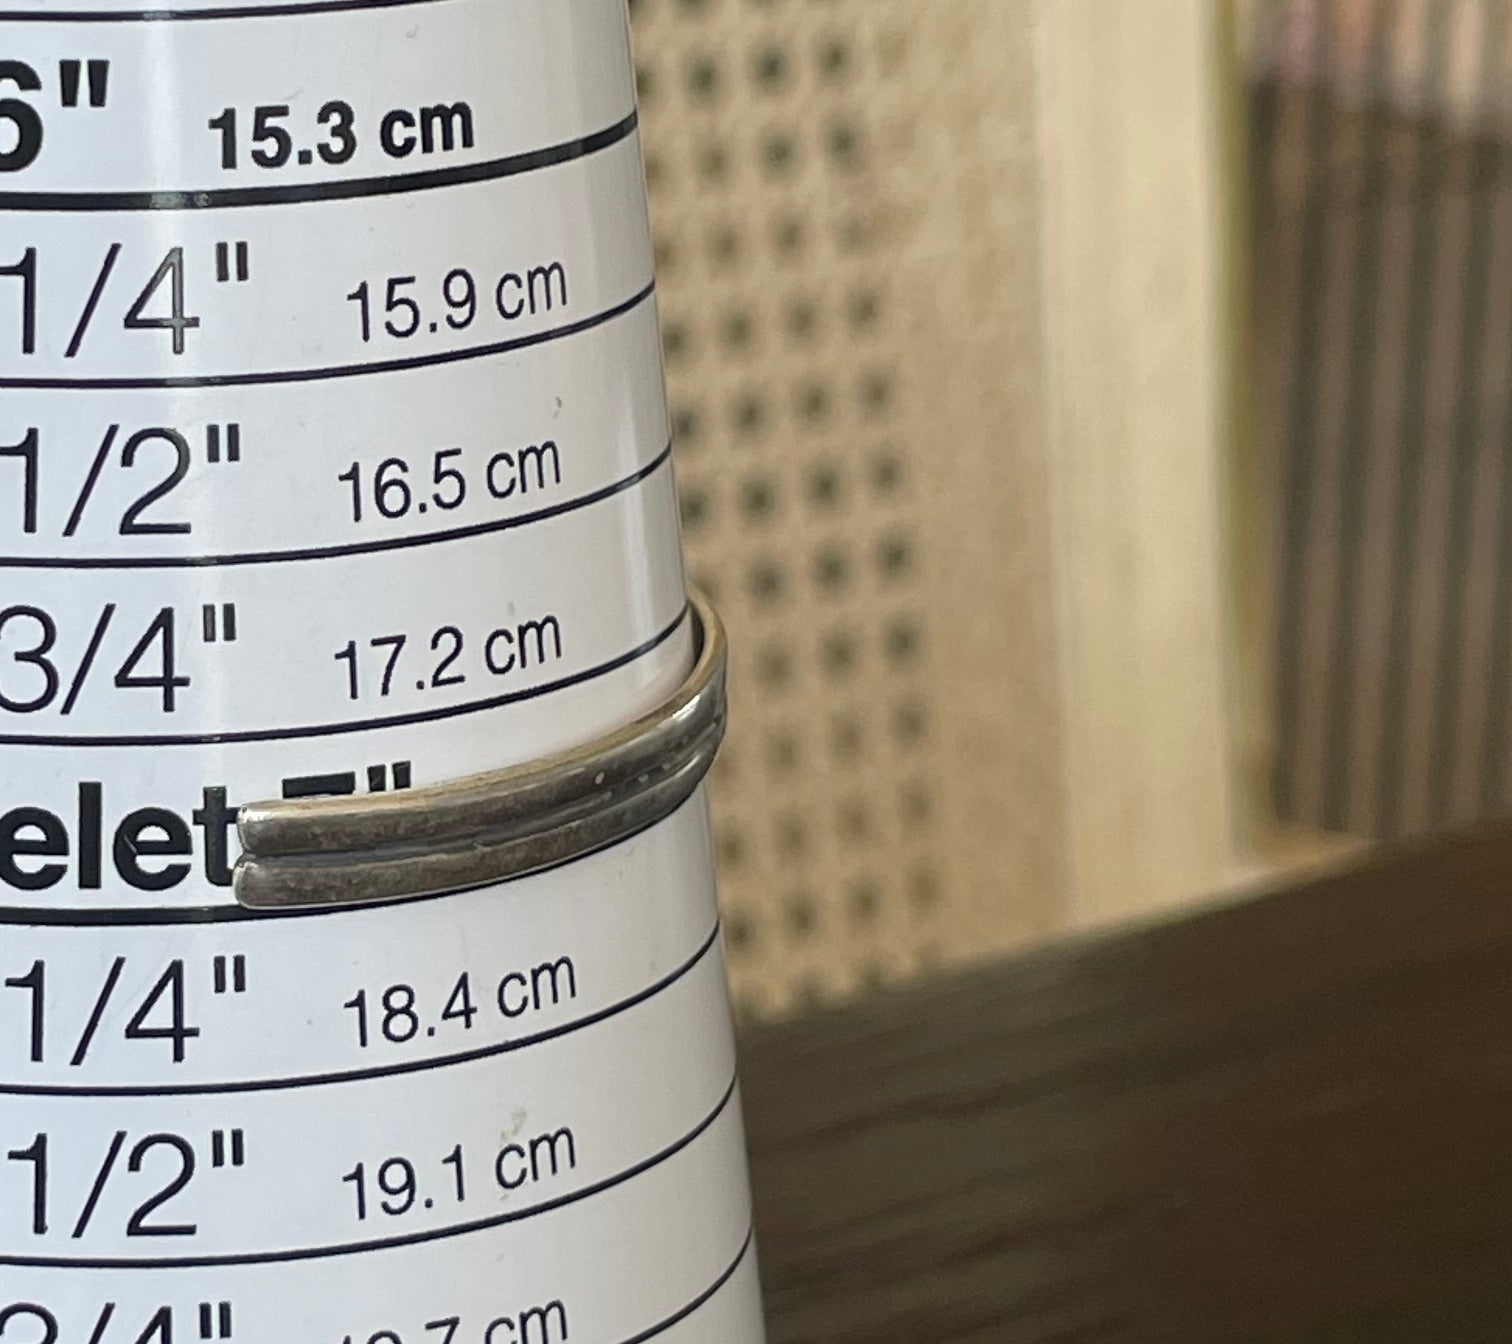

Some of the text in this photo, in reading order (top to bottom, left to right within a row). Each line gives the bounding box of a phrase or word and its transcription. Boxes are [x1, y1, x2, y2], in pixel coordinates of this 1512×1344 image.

[207, 99, 357, 170] 15.3
[379, 101, 475, 159] cm
[346, 267, 477, 343] 15.9
[495, 261, 568, 321] cm
[337, 447, 466, 523] 16.5
[486, 440, 561, 500] cm
[333, 625, 466, 701] 17.2
[484, 614, 562, 684] cm
[3, 954, 247, 1067] 1/4"
[342, 971, 478, 1049] 18.4
[496, 955, 577, 1019] cm
[7, 1127, 245, 1239] 1/2"
[341, 1143, 465, 1221] 19.1
[494, 1126, 576, 1190] cm
